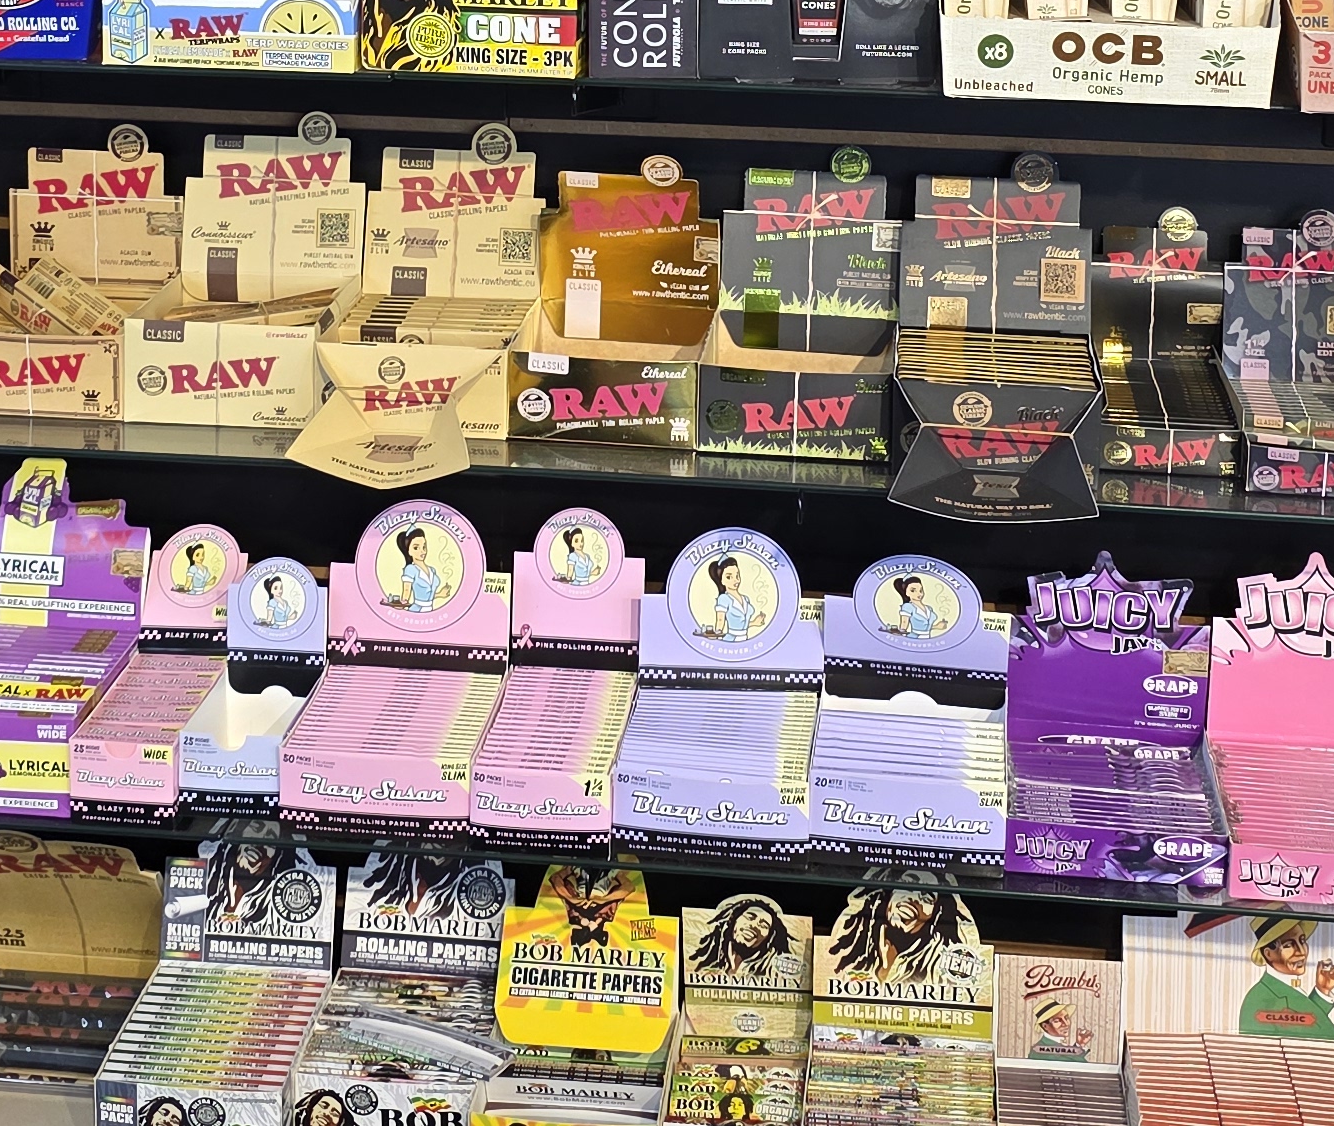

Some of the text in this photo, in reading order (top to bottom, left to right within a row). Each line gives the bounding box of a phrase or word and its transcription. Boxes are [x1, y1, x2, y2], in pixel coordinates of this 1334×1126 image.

[9, 17, 58, 31] ROLLING
[60, 15, 79, 31] CO.
[467, 15, 561, 44] CONE
[456, 49, 491, 67] KING
[495, 49, 528, 67] SIZE
[543, 47, 573, 67] 3PK
[984, 44, 1008, 60] x8
[1051, 32, 1164, 65] OCB
[1053, 68, 1164, 86] Organic Hemp
[1195, 70, 1246, 86] SMALL
[954, 79, 1033, 93] Unbleached
[650, 260, 707, 277] Ethereal
[1033, 580, 1180, 631] JUICY
[1143, 677, 1198, 695] GRAPE
[37, 727, 66, 739] WIDE
[441, 771, 467, 781] SLIM
[301, 773, 447, 804] Blazy Susan
[857, 845, 954, 861] DELUXE ROLLING KIT
[511, 965, 662, 994] CIGARETTE PAPERS
